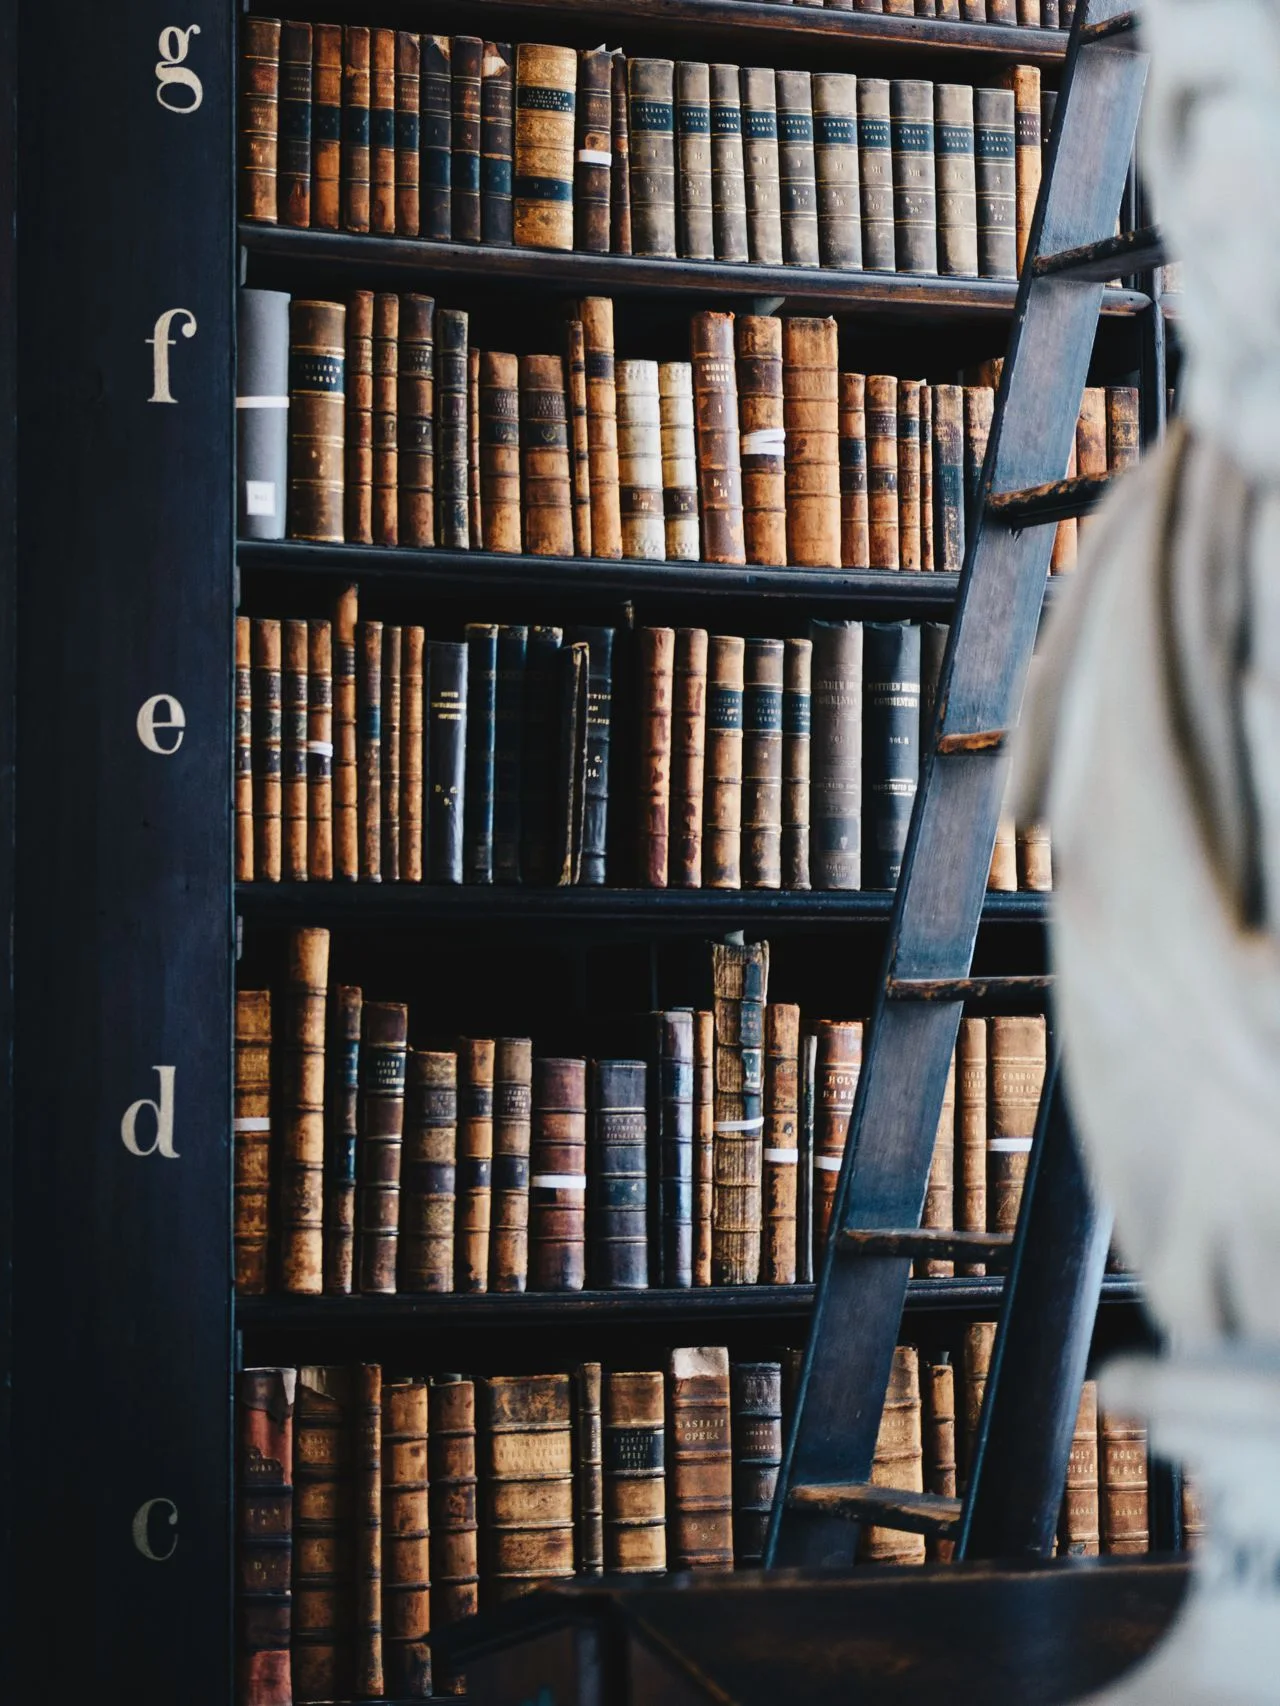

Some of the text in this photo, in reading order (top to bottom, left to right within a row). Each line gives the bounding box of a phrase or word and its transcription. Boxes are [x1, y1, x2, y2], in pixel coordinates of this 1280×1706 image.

[154, 23, 204, 114] g
[145, 308, 197, 404] f
[136, 693, 186, 755] e
[121, 1065, 181, 1159] d
[823, 1090, 854, 1100] BIBL
[677, 1419, 725, 1429] BASILII
[684, 1431, 720, 1441] OPERA
[1111, 1464, 1143, 1475] BIBLE
[1113, 1450, 1138, 1459] HOLY
[131, 1497, 179, 1561] c
